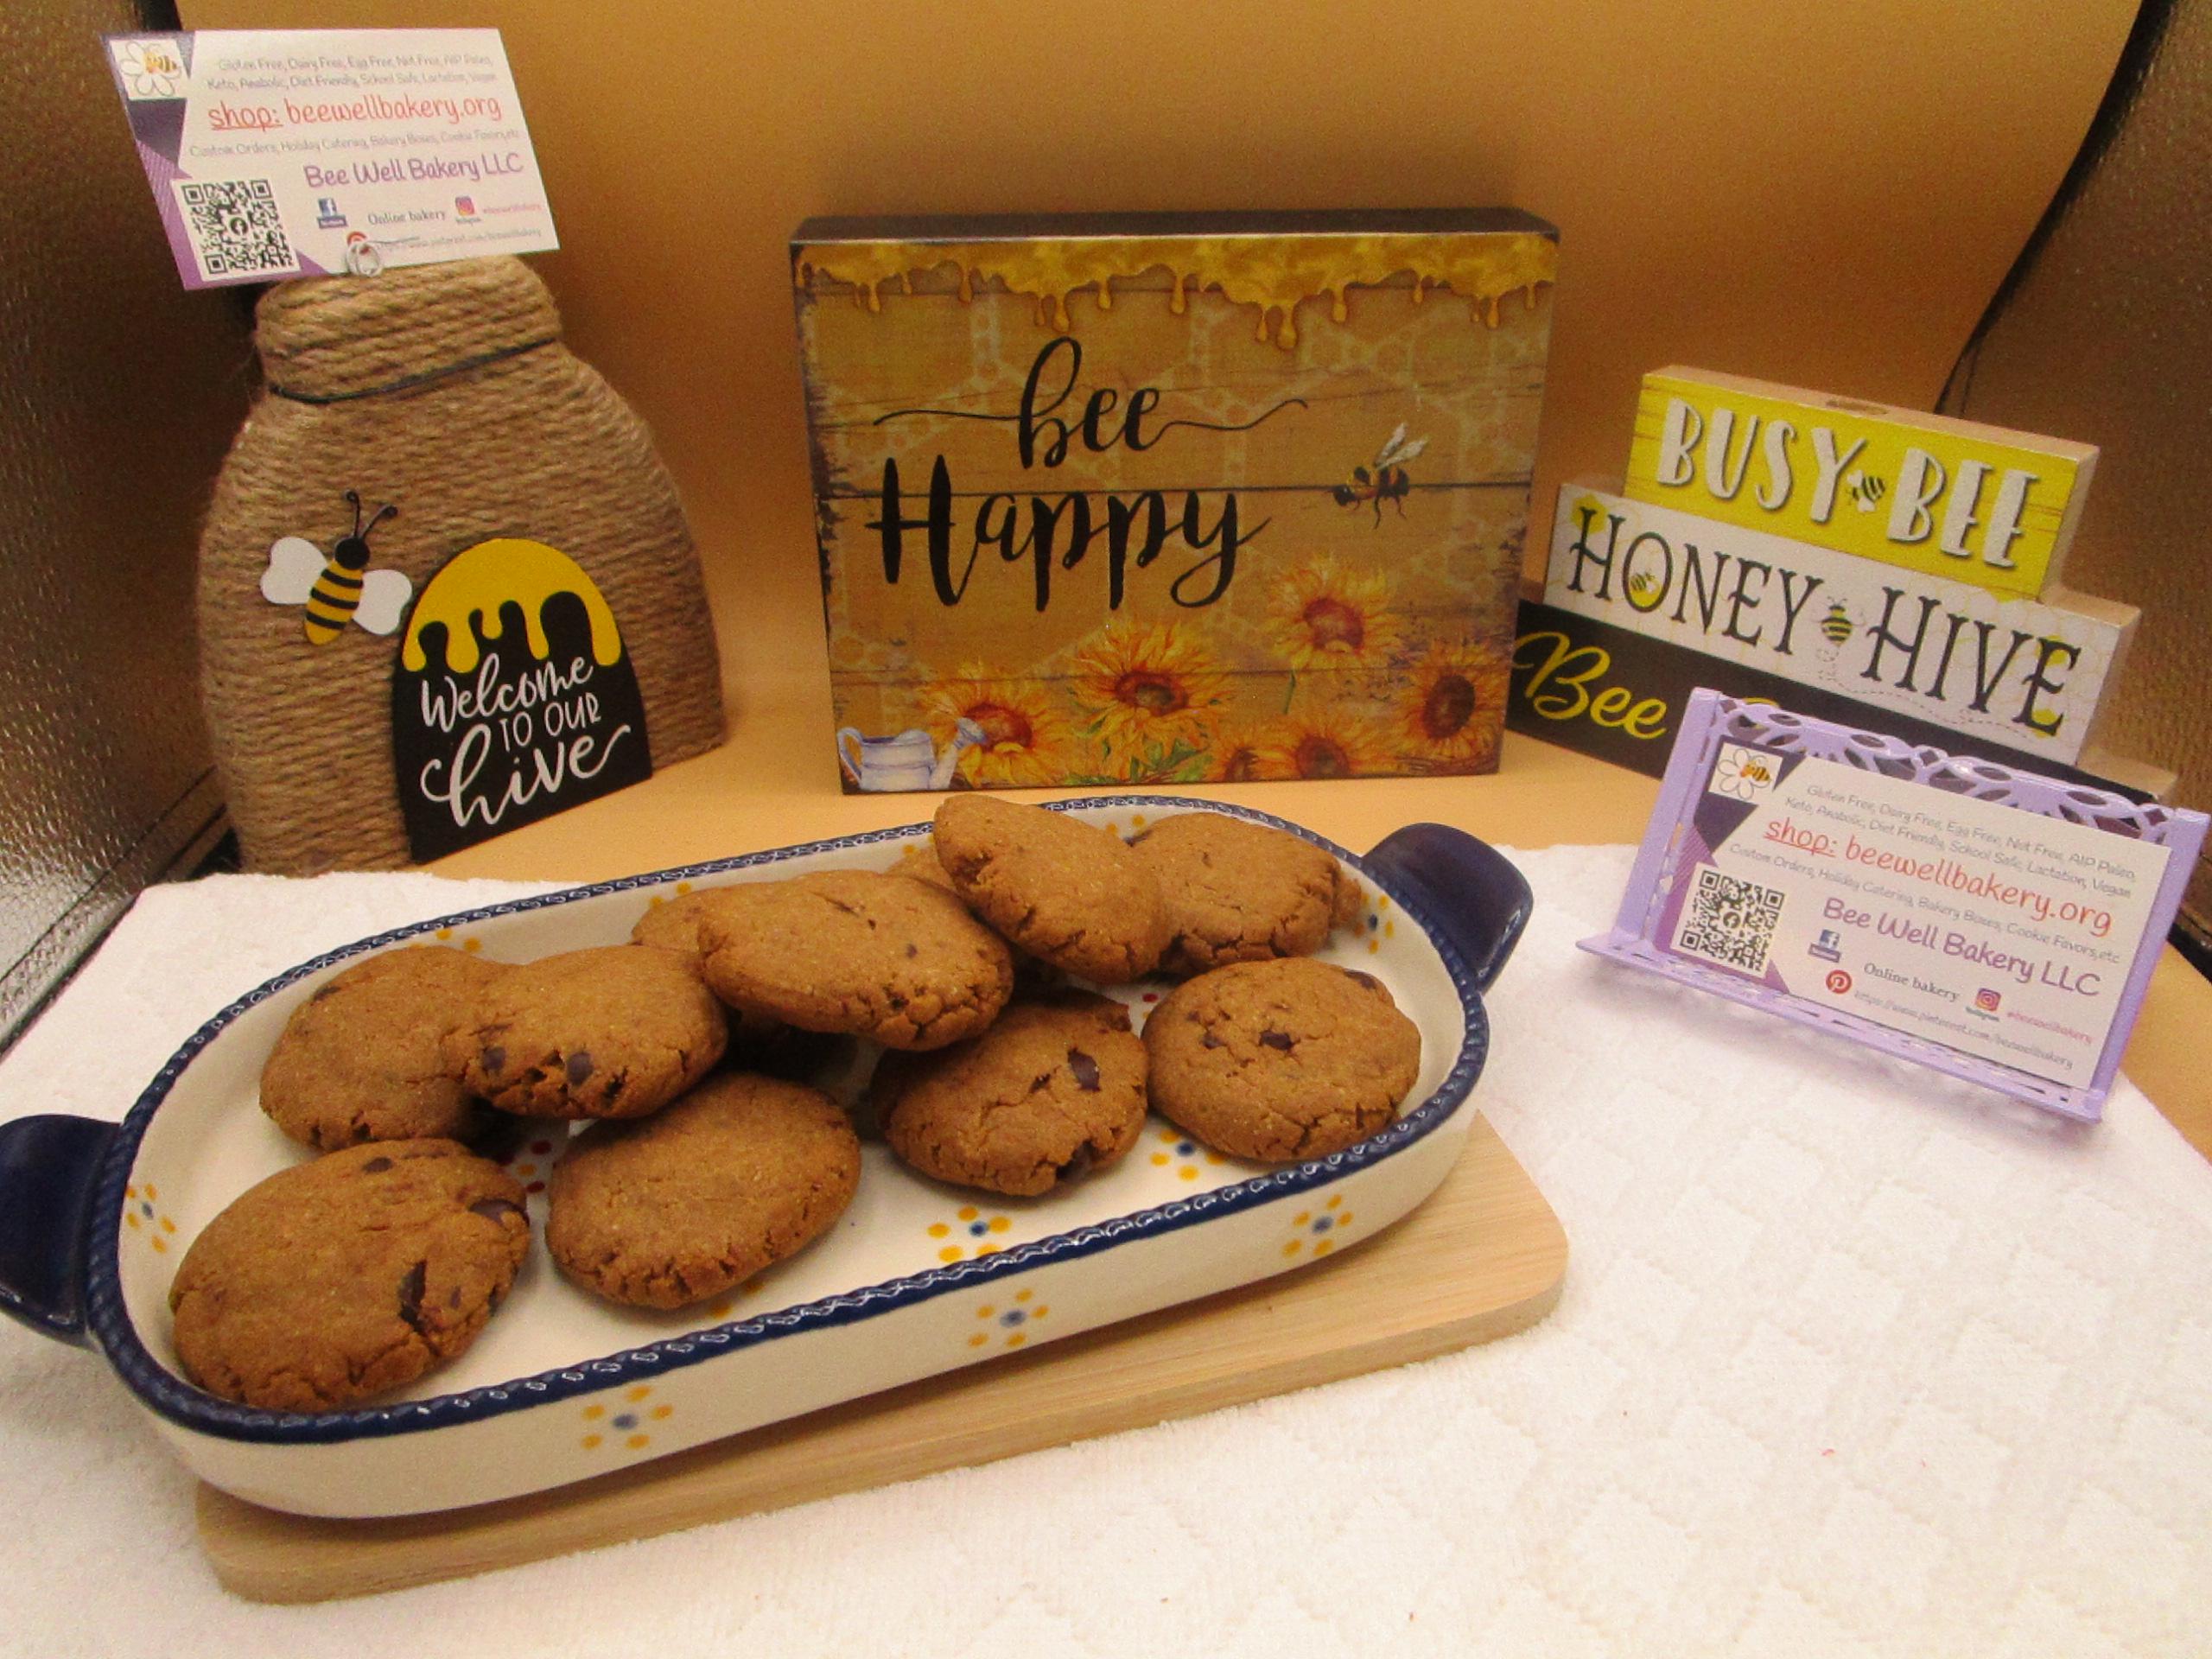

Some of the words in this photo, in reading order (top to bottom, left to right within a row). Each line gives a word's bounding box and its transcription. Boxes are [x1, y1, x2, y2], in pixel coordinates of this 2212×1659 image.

[208, 99, 283, 132] shop:
[283, 92, 503, 124] beewellbakery.org
[303, 164, 350, 188] Bee
[353, 158, 407, 184] Well
[408, 156, 480, 182] Bakery
[481, 152, 524, 175] LLC
[368, 213, 406, 225] Online
[409, 209, 446, 223] bakery
[1655, 396, 1868, 524] BUSY
[1886, 446, 2040, 569] BEE
[864, 454, 1272, 612] Happy
[1567, 505, 1824, 657] HONEY
[1859, 584, 2083, 737] HIVE
[420, 652, 594, 734] Welcome
[499, 711, 533, 752] TO
[543, 691, 602, 737] OUR
[1512, 631, 1669, 740] Bee
[419, 722, 632, 827] hive
[1763, 817, 1838, 857] shop:
[1846, 833, 2113, 938] beewellbakery.org
[1823, 897, 1872, 929] Bee
[1878, 912, 1939, 950] Well
[1943, 932, 2035, 984] Bakery
[2040, 960, 2101, 996] LLC
[1864, 962, 1910, 987] Online
[1912, 976, 1961, 1002] bakery
